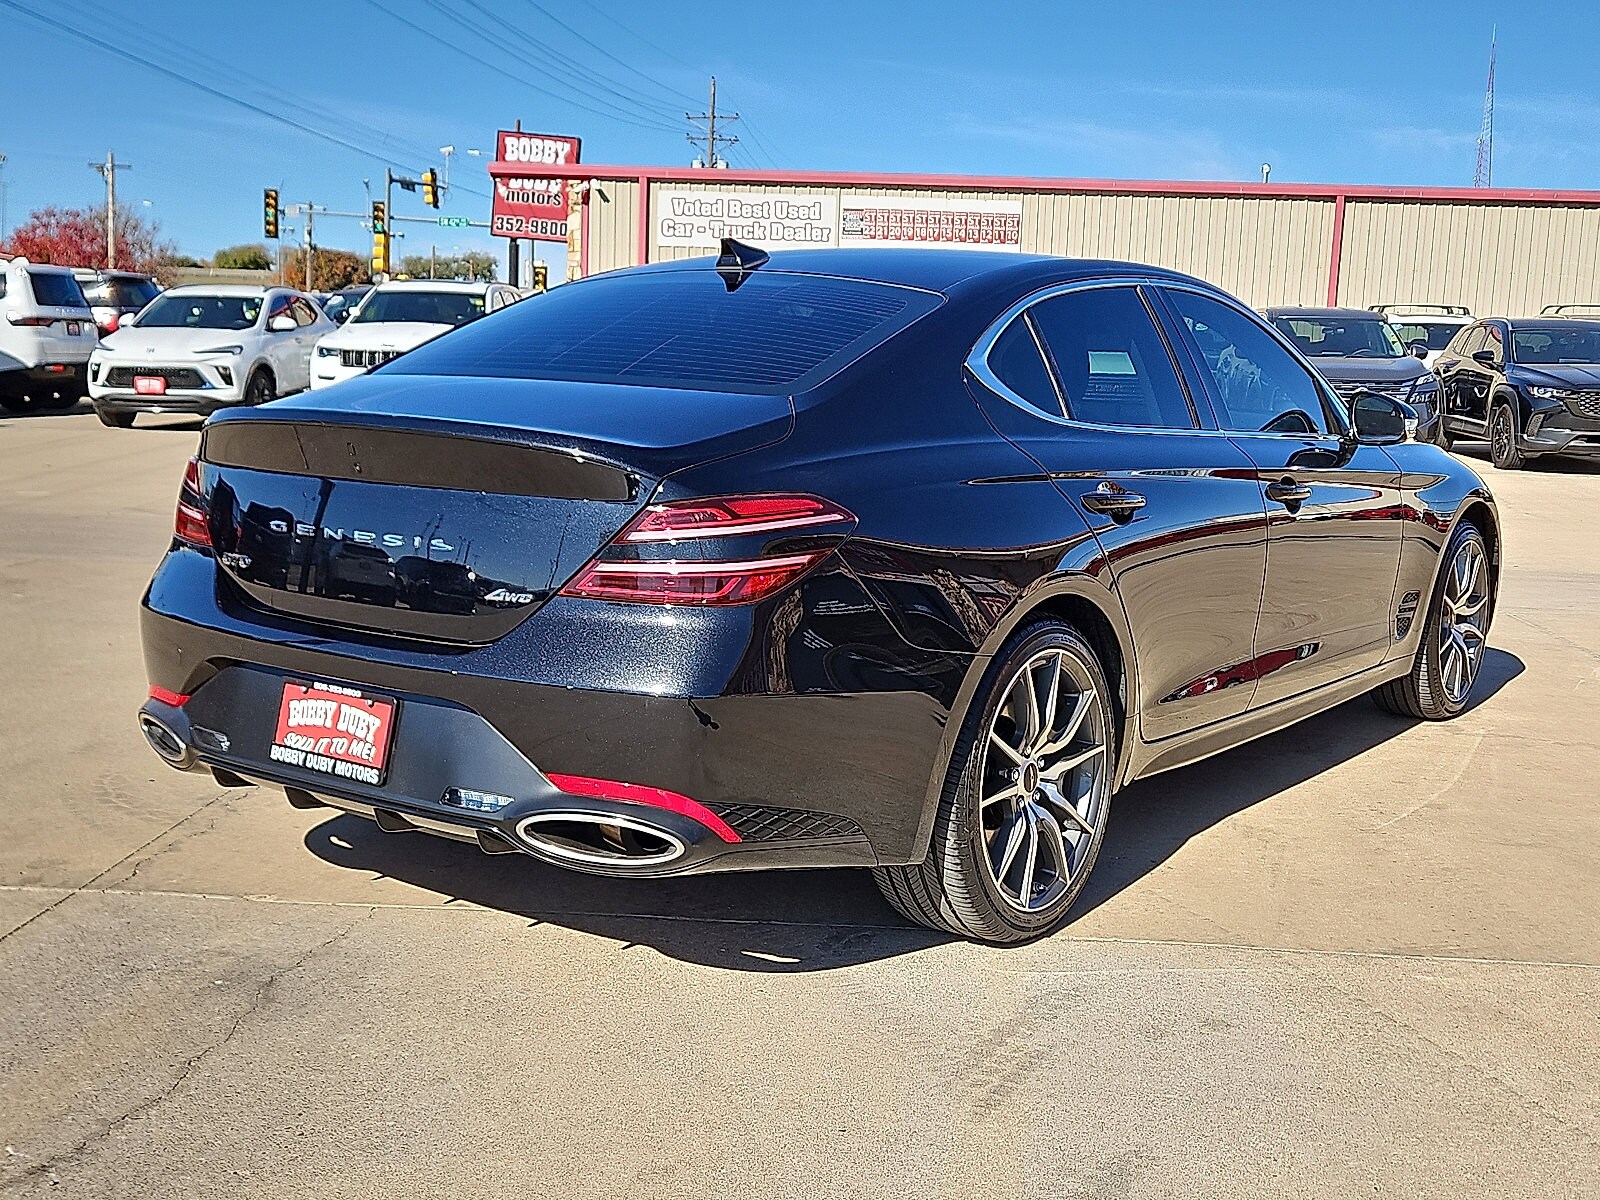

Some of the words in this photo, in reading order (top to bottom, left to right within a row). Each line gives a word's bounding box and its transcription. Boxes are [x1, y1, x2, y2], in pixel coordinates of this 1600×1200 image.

[504, 136, 571, 165] BOBBY
[506, 190, 562, 206] motors
[671, 197, 723, 217] Voted
[727, 199, 770, 219] Best
[774, 200, 821, 220] Used
[495, 216, 568, 237] 352-9800
[661, 218, 693, 237] Car
[709, 220, 766, 240] Truck
[770, 222, 831, 242] Dealer
[864, 226, 876, 235] 22
[890, 226, 901, 236] 20
[903, 227, 914, 236] 19
[916, 227, 926, 237] 18
[930, 228, 940, 237] 17
[942, 228, 952, 237] 15
[968, 229, 979, 239] 13
[982, 230, 992, 240] 12
[995, 230, 1005, 240] 11
[1007, 230, 1018, 240] 10
[268, 519, 455, 552] GENESIS
[287, 699, 338, 729] BOBBY
[336, 703, 381, 743] DUBY
[283, 731, 314, 752] SOLD
[314, 737, 333, 754] IT
[329, 737, 348, 755] TO
[348, 738, 377, 763] ME!
[269, 744, 307, 767] BOBBY
[305, 753, 336, 775] DUBY
[334, 760, 380, 785] MOTORS
